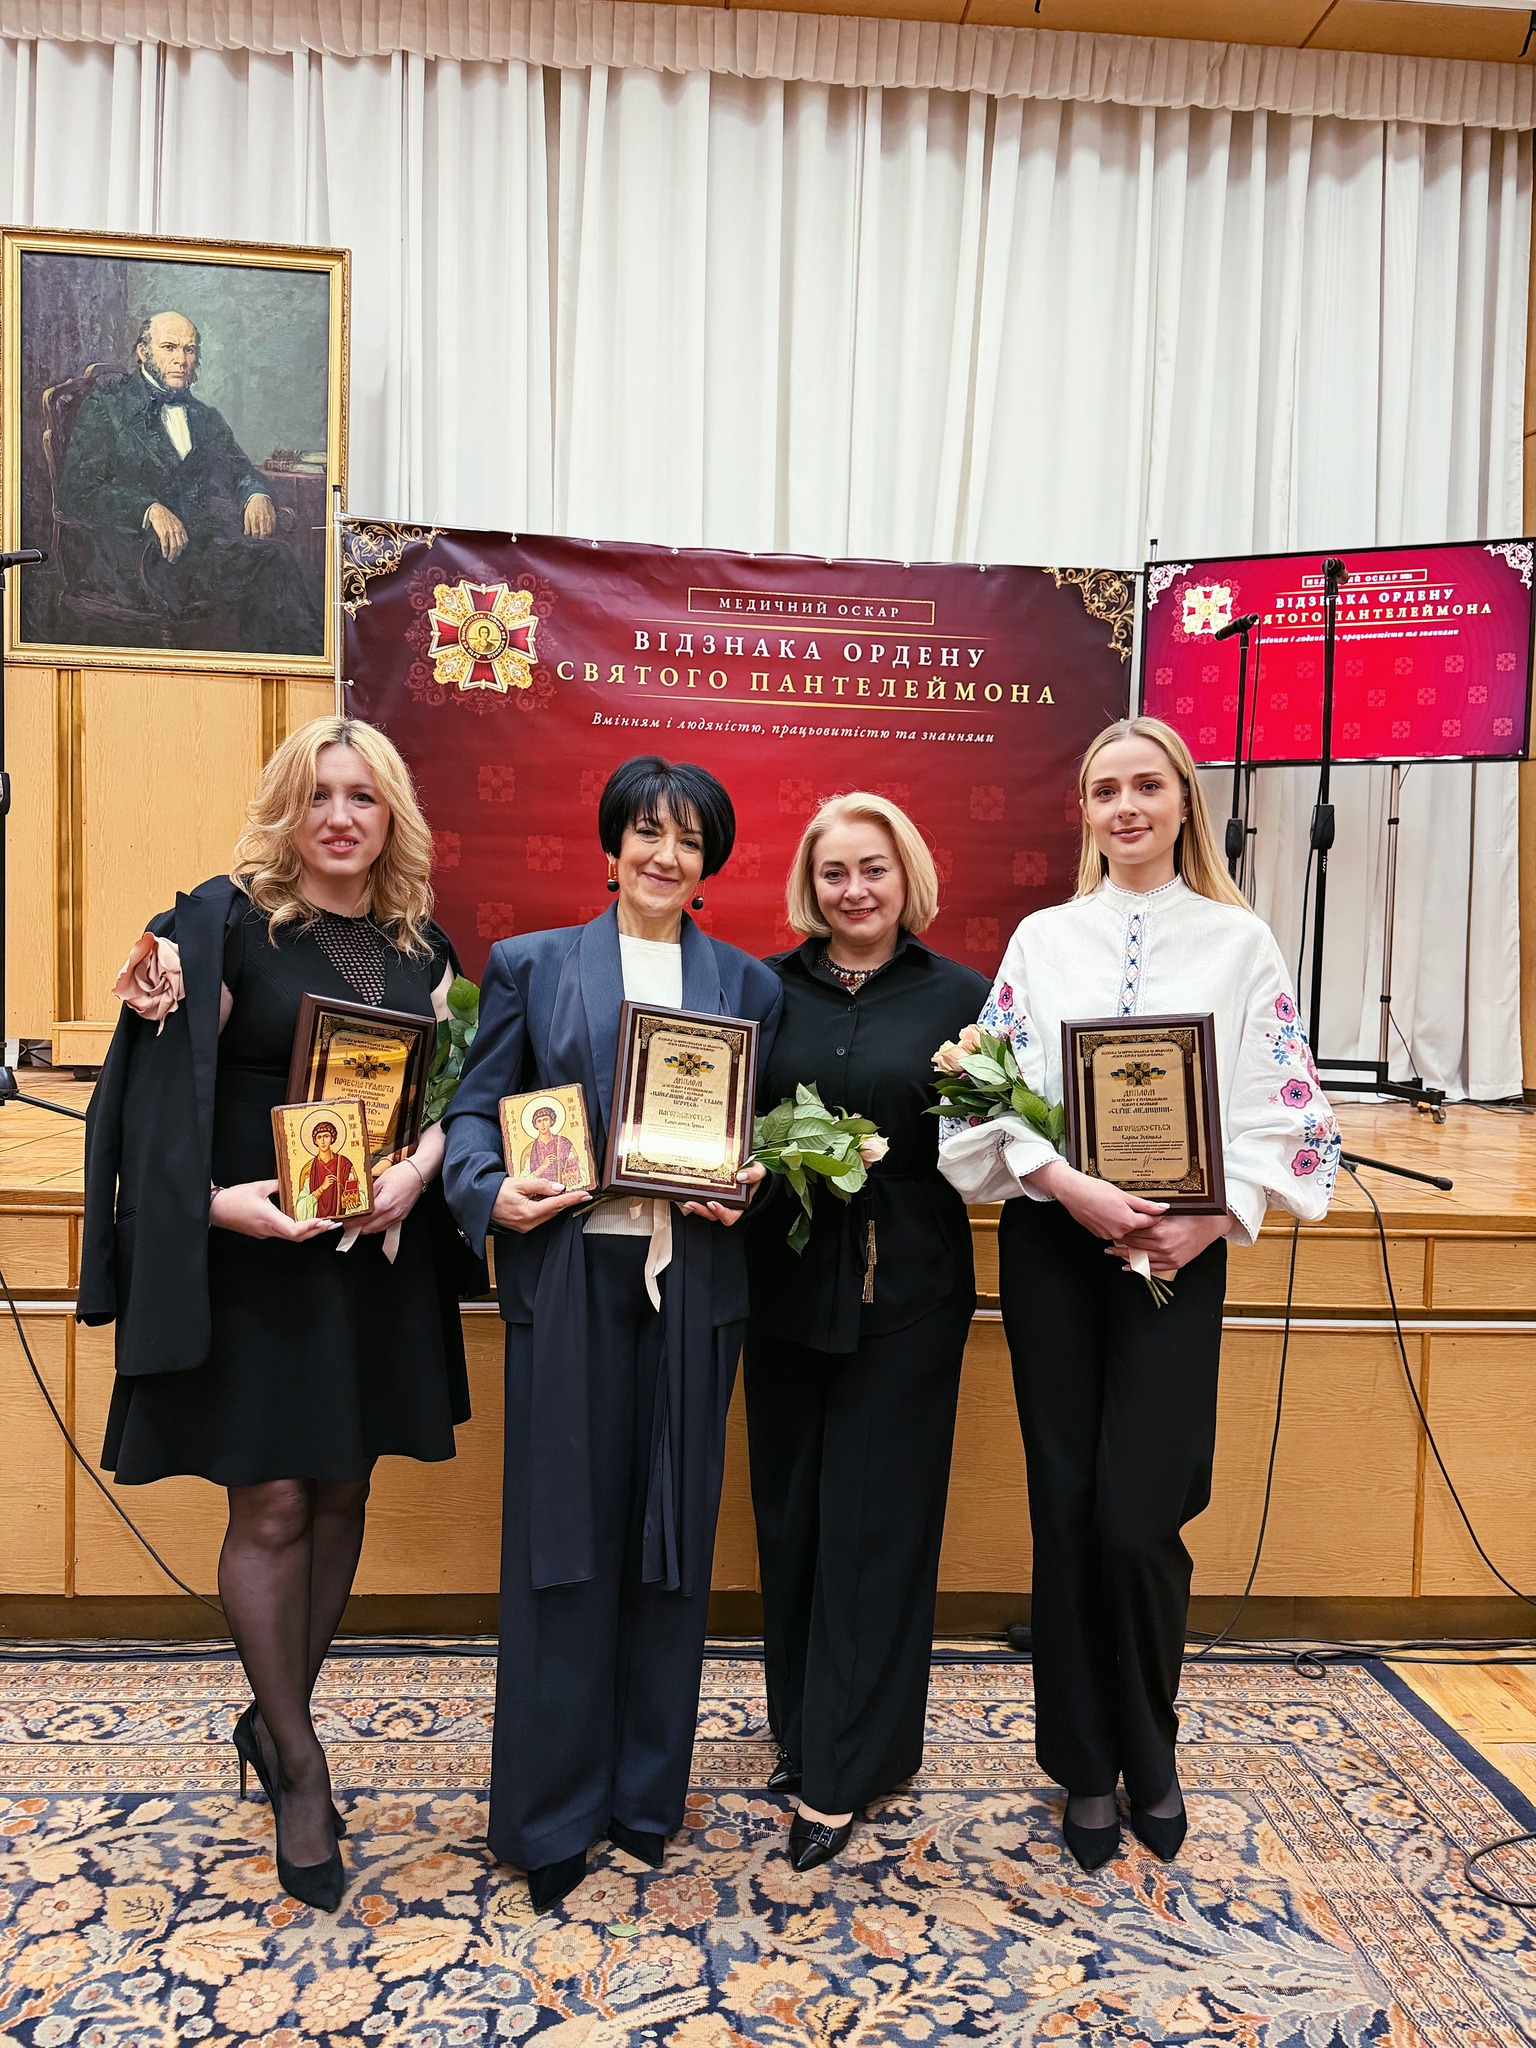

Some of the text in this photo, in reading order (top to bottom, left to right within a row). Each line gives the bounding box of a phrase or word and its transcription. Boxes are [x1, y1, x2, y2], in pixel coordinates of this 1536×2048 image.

[1365, 574, 1398, 582] ОСКАР
[719, 597, 899, 617] МЕДИЧНИЙ ОСКАР
[1276, 588, 1454, 610] ВІДЗНАКА ОРДЕНУ
[1335, 603, 1492, 621] ПАНТЕЛЕЙМОНА
[634, 630, 985, 669] ВІДЗНАКА ОРДЕНУ
[556, 660, 1055, 705] СВЯТОГО ПАНТЕЛЕЙМОНА
[592, 712, 995, 743] Вмінням і людяністю, працьовитістю та знаннями
[1123, 1089, 1156, 1098] ДИПЛОМ
